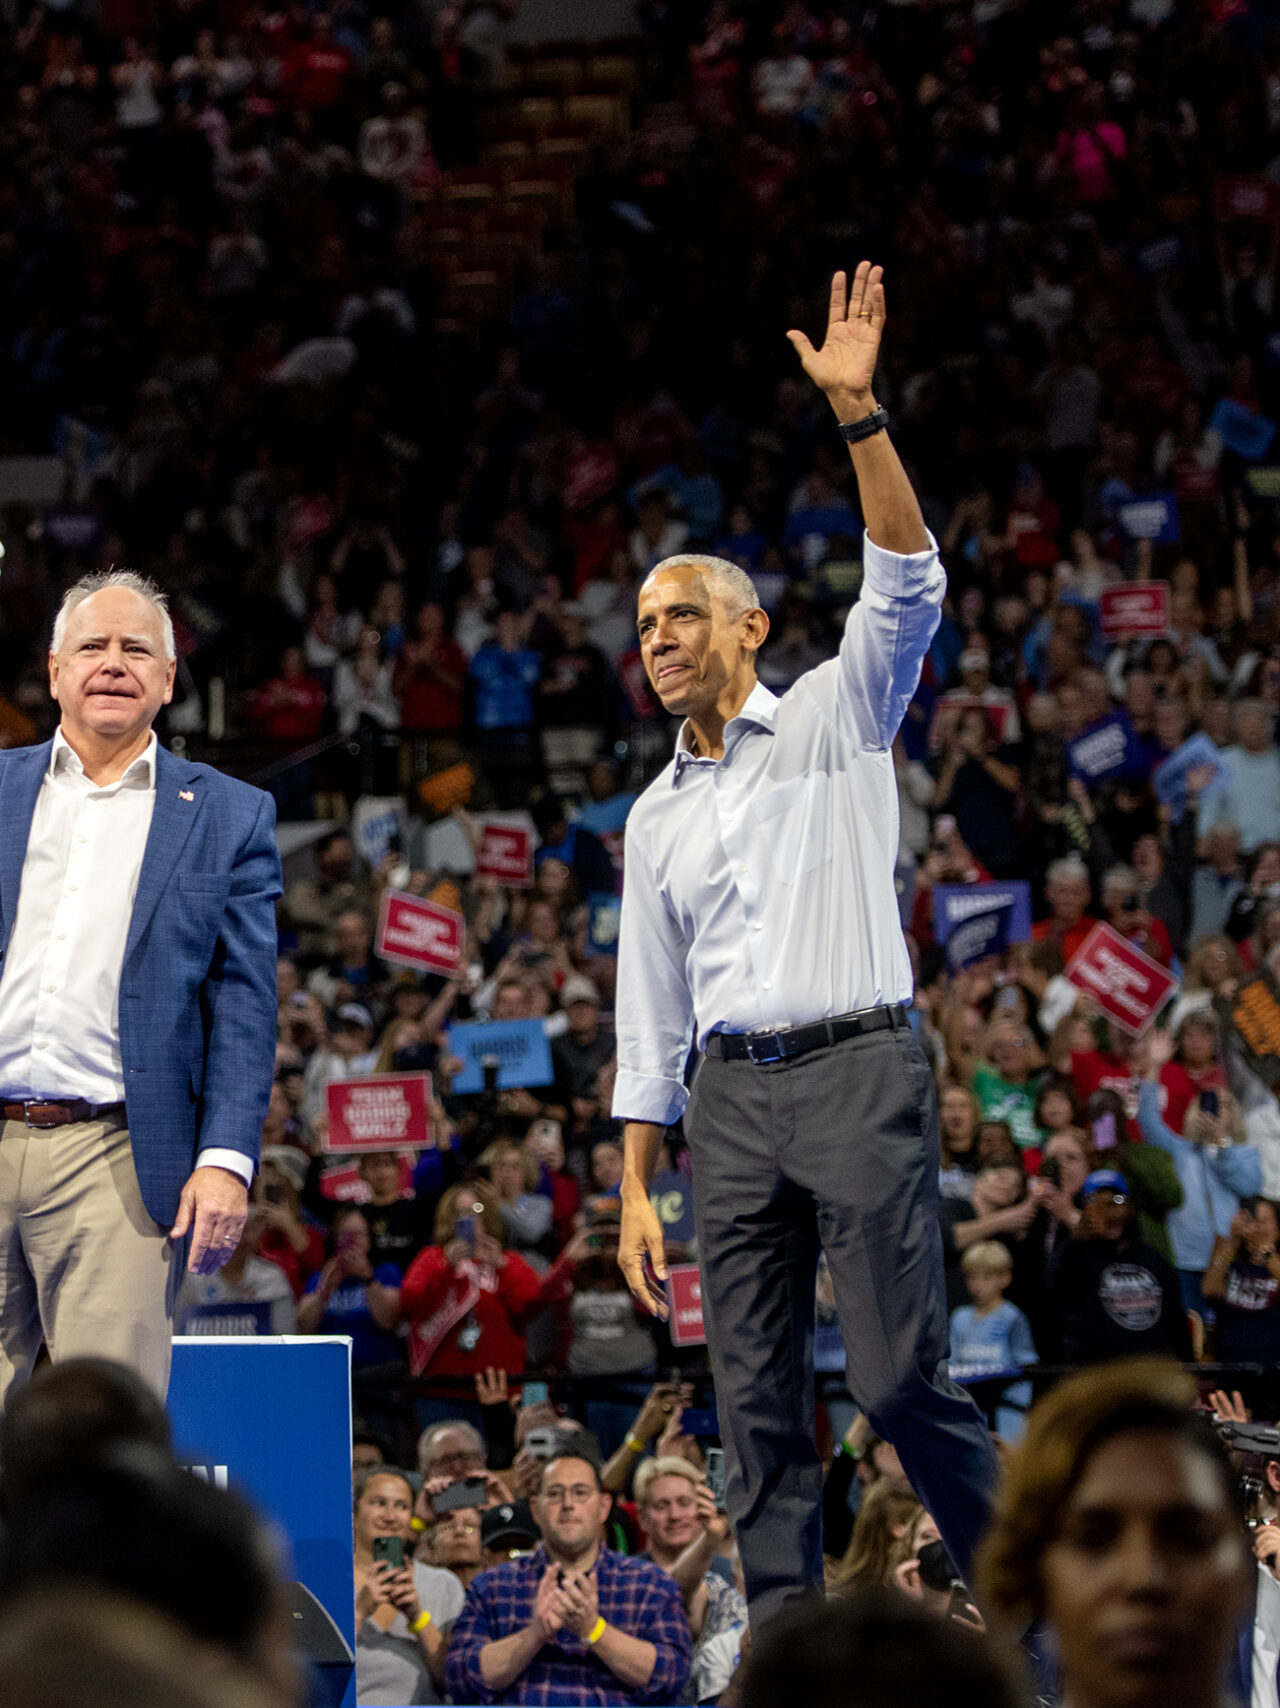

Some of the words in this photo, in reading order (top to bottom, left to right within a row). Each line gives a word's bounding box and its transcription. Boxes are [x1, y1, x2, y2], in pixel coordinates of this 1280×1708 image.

[349, 1087, 403, 1105] TEAM
[344, 1104, 410, 1122] HARRIS
[350, 1119, 407, 1138] WALZ
